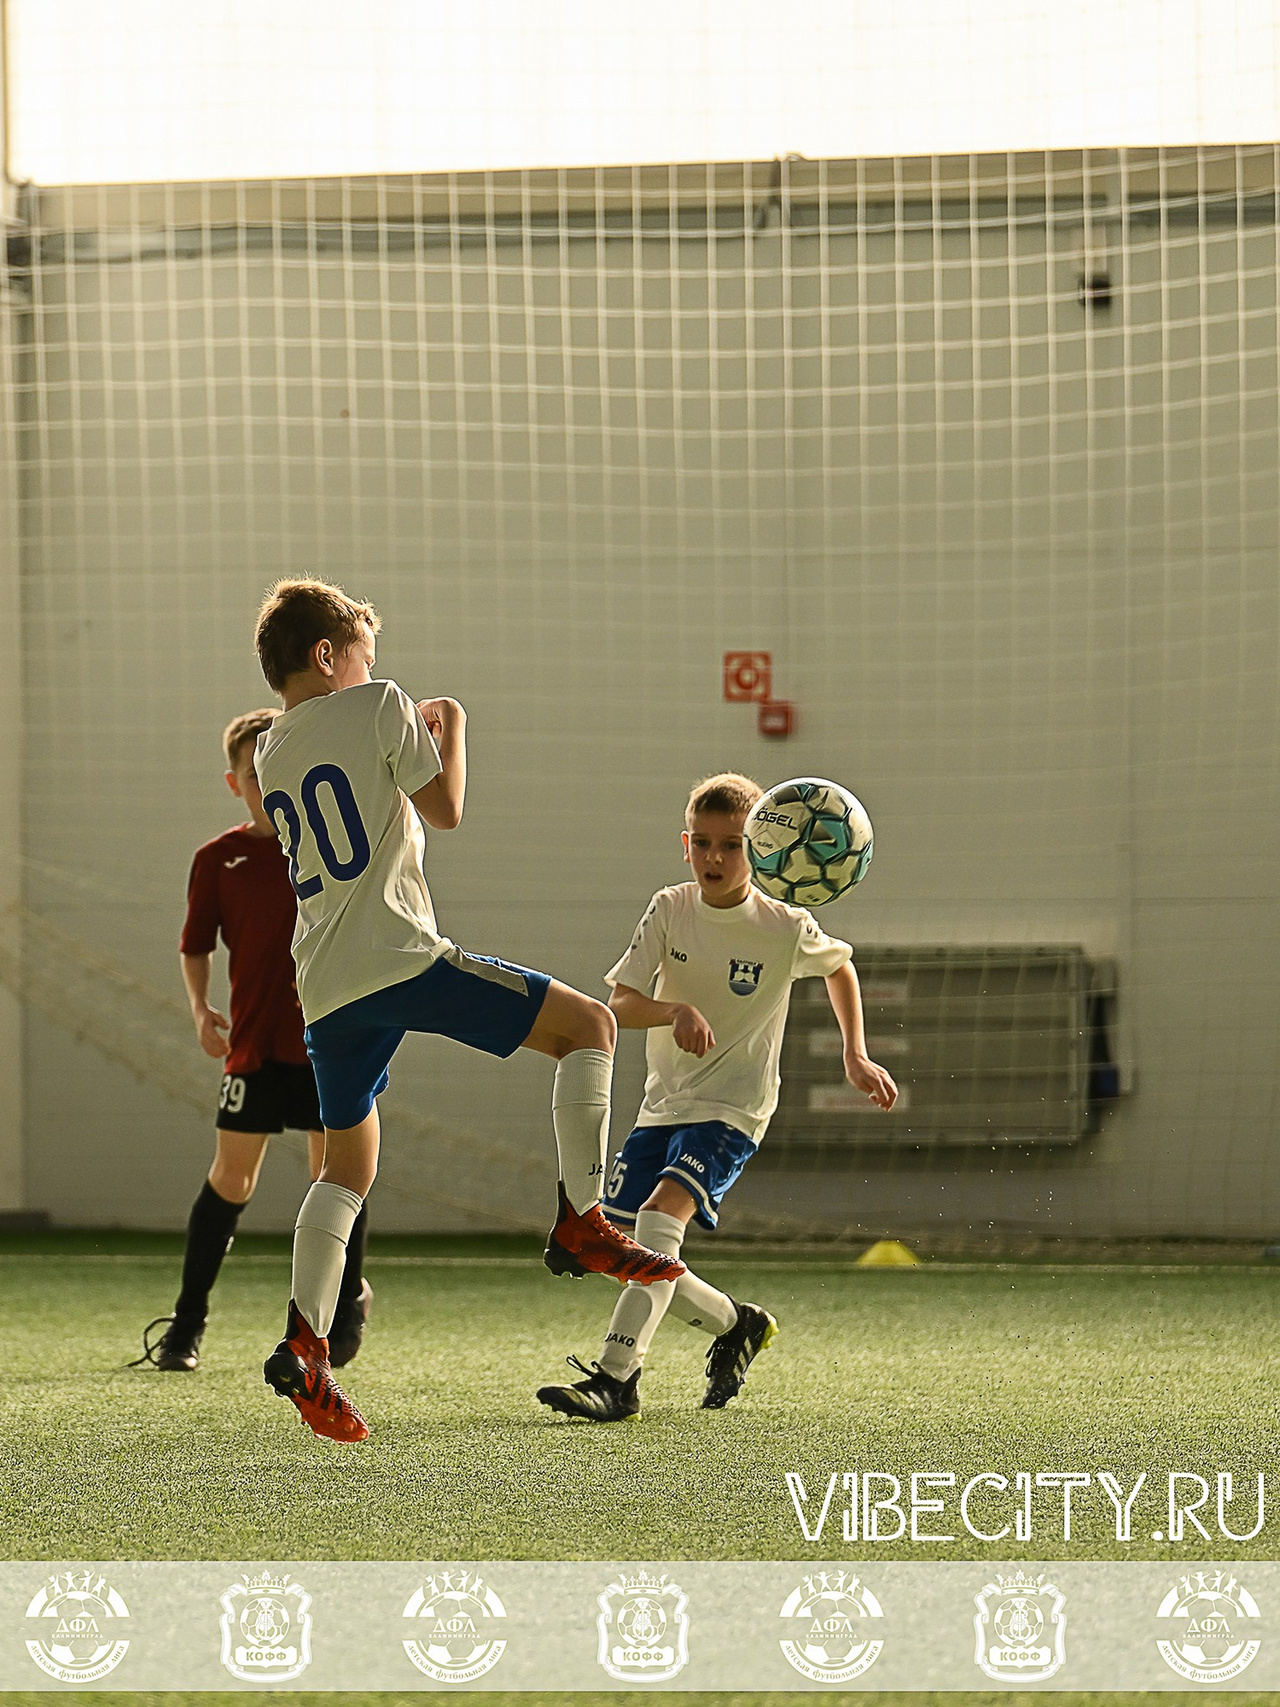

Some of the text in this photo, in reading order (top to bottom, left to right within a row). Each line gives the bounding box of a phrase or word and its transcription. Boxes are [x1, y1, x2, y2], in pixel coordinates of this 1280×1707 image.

[263, 763, 370, 901] 20
[606, 1151, 628, 1199] 5
[680, 1153, 706, 1174] JAKO
[605, 1332, 636, 1348] JAKO
